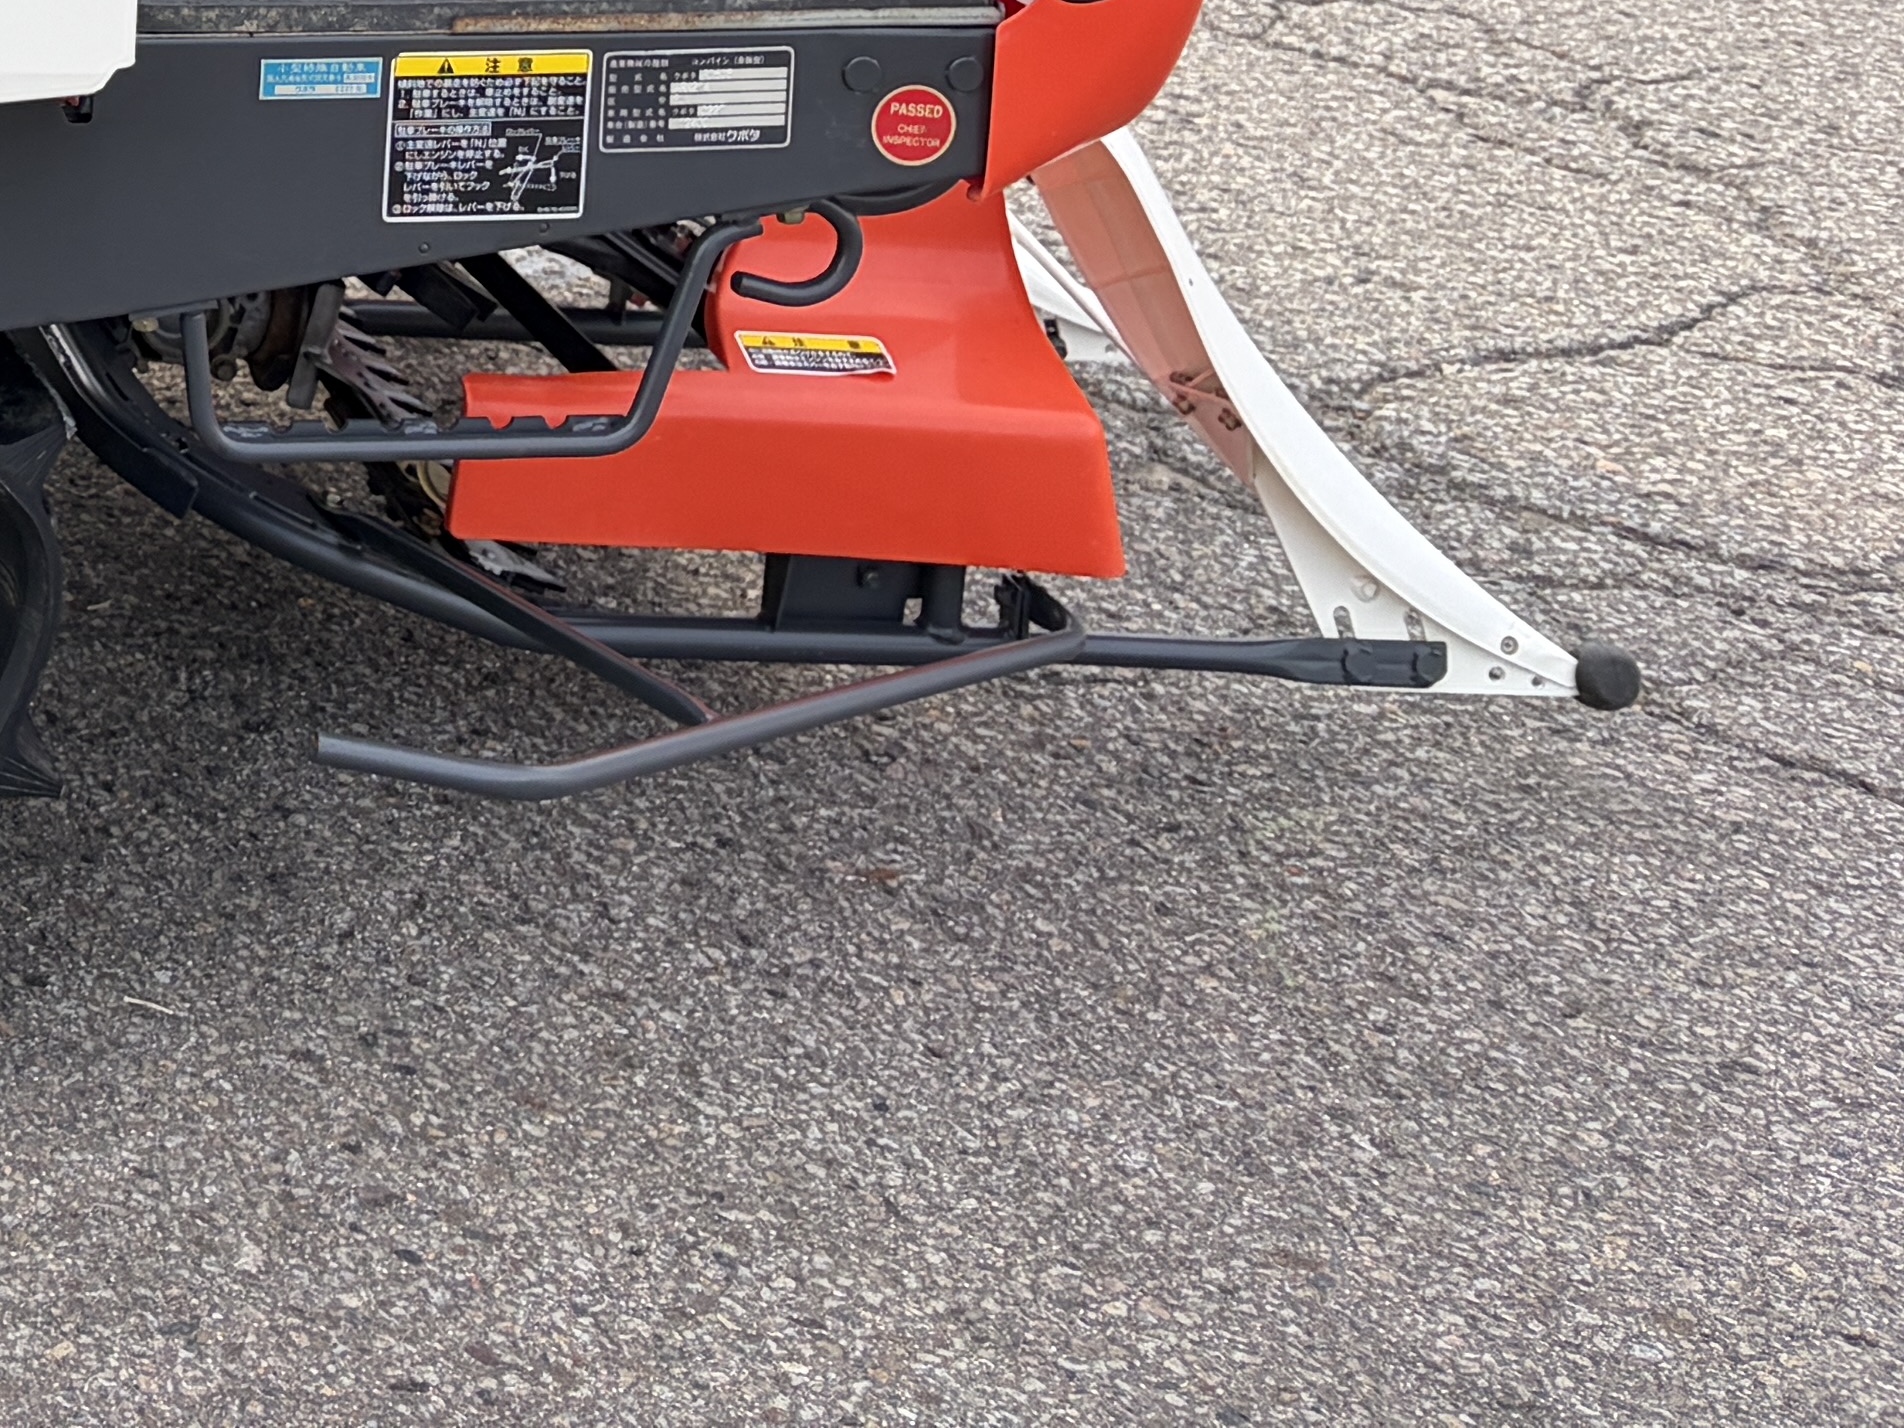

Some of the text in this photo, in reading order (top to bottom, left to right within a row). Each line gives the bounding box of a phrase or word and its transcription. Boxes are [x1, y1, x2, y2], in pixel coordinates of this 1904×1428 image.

[484, 57, 534, 74] 注意
[890, 102, 944, 119] PASSED
[882, 134, 941, 148] INSPECTOR
